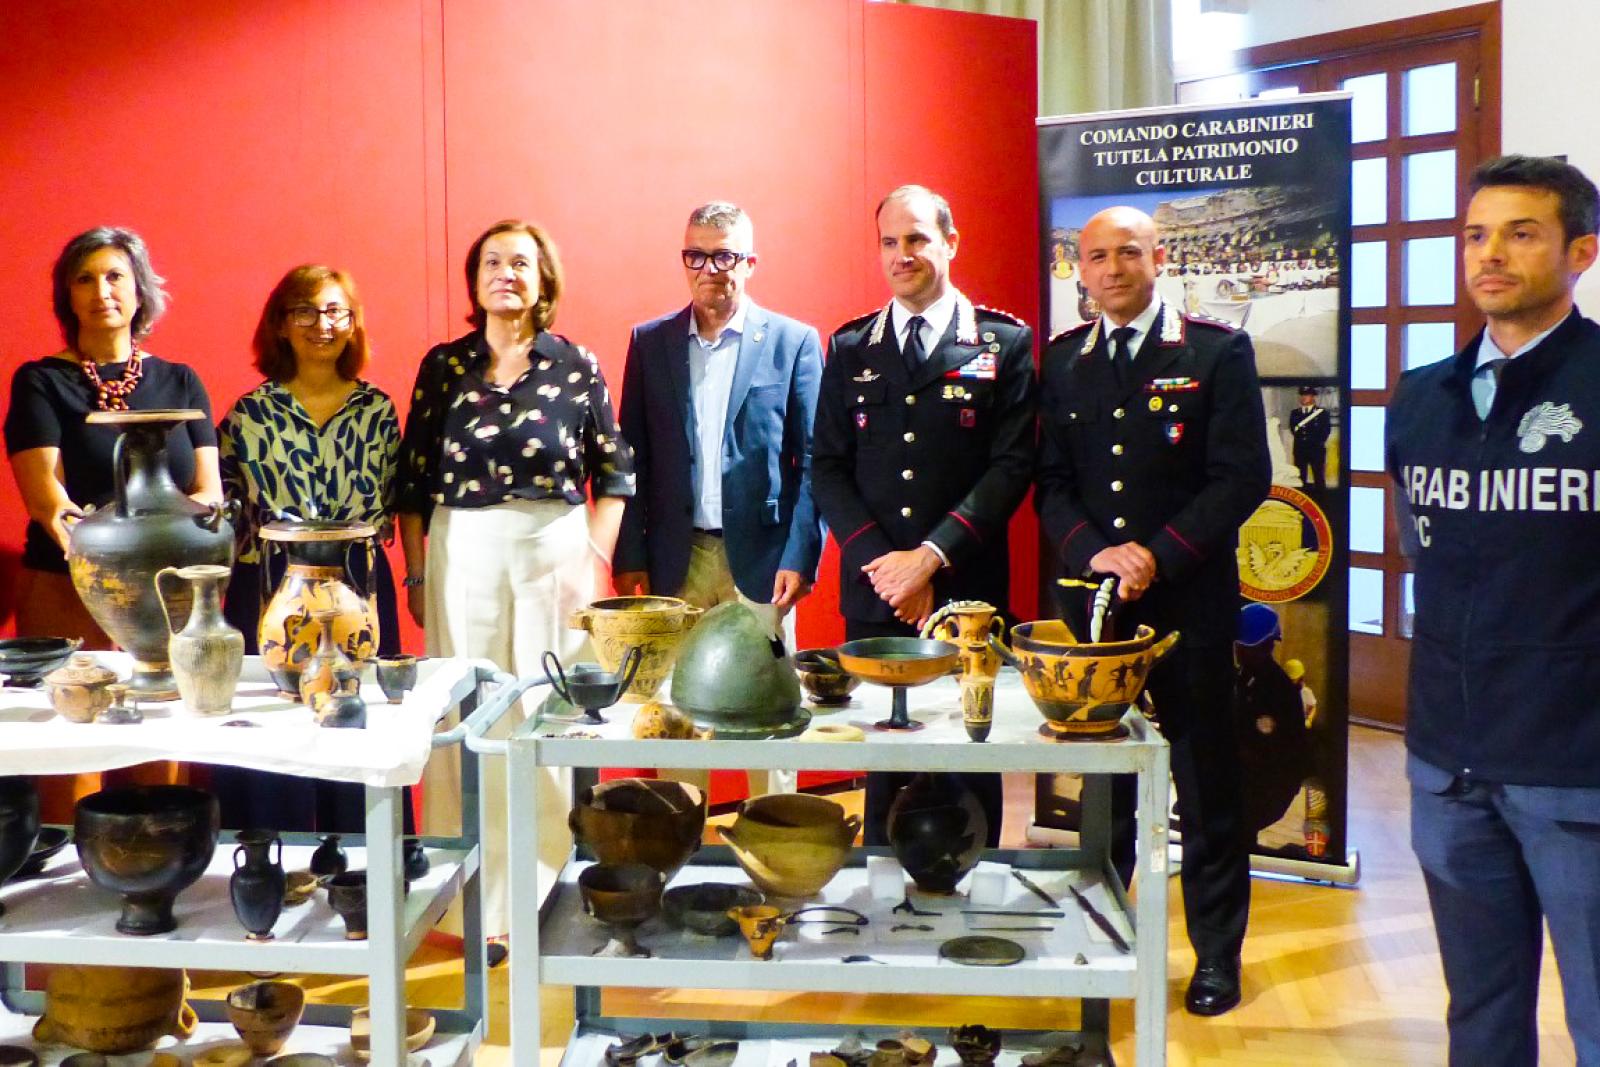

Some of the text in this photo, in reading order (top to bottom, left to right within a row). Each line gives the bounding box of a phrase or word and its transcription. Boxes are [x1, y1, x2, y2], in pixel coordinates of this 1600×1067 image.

[1080, 112, 1315, 146] COMANDO CARABINIERI
[1094, 138, 1299, 167] TUTELA PATRIMONIO
[1135, 164, 1252, 186] CULTURALE
